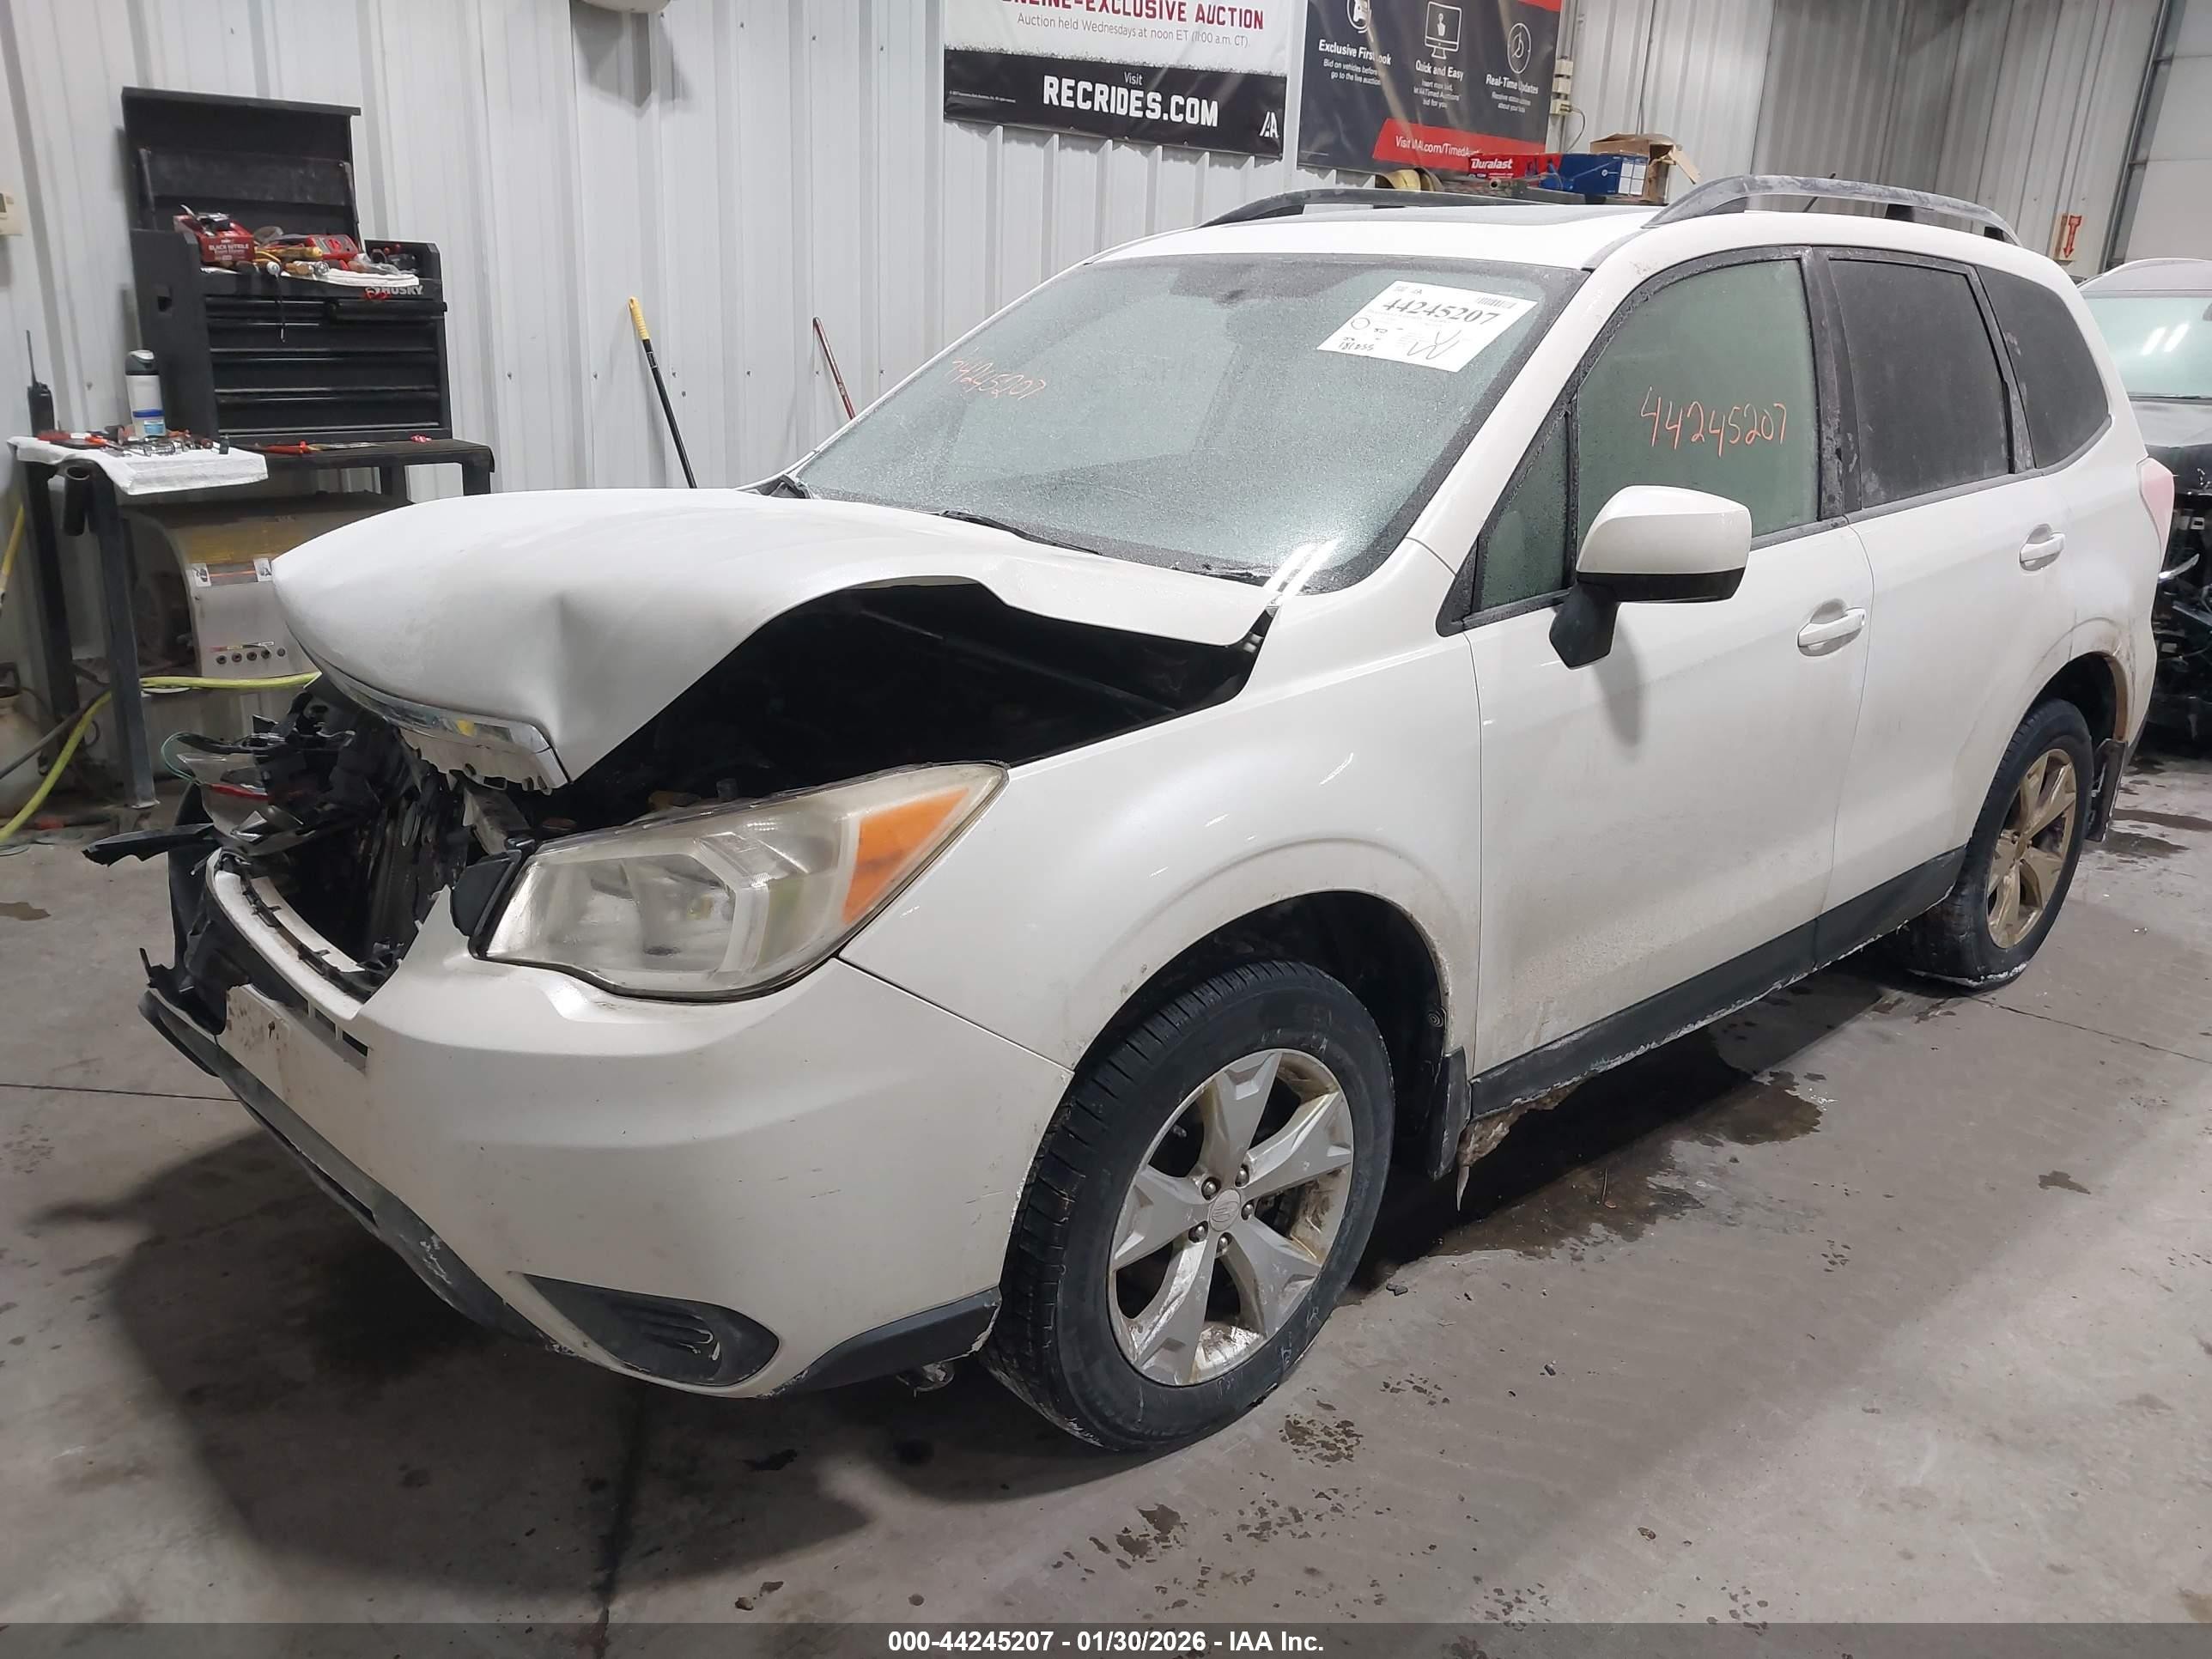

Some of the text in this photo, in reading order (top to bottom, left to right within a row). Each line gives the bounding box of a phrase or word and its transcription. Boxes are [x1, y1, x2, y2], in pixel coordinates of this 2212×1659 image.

[1018, 13, 1056, 28] Auction
[1058, 16, 1079, 30] held
[1081, 20, 1136, 38] Wednesdays
[1138, 28, 1147, 38] at
[1151, 29, 1174, 40] noon
[1176, 31, 1188, 41] ET
[1194, 3, 1264, 29] AUCTION
[1319, 40, 1357, 58] Exclusive
[1376, 53, 1391, 65] ook
[1323, 58, 1334, 68] Bid
[1124, 71, 1143, 85] Visit
[1416, 59, 1463, 82] Quick and Easy
[1486, 74, 1538, 94] Real-Time Updates
[1043, 75, 1218, 127] RECRIDES.COM
[1395, 136, 1411, 149] Visit
[1471, 158, 1513, 169] Duralast
[1382, 298, 1501, 325] 44245207
[1641, 386, 1787, 457] 44245207
